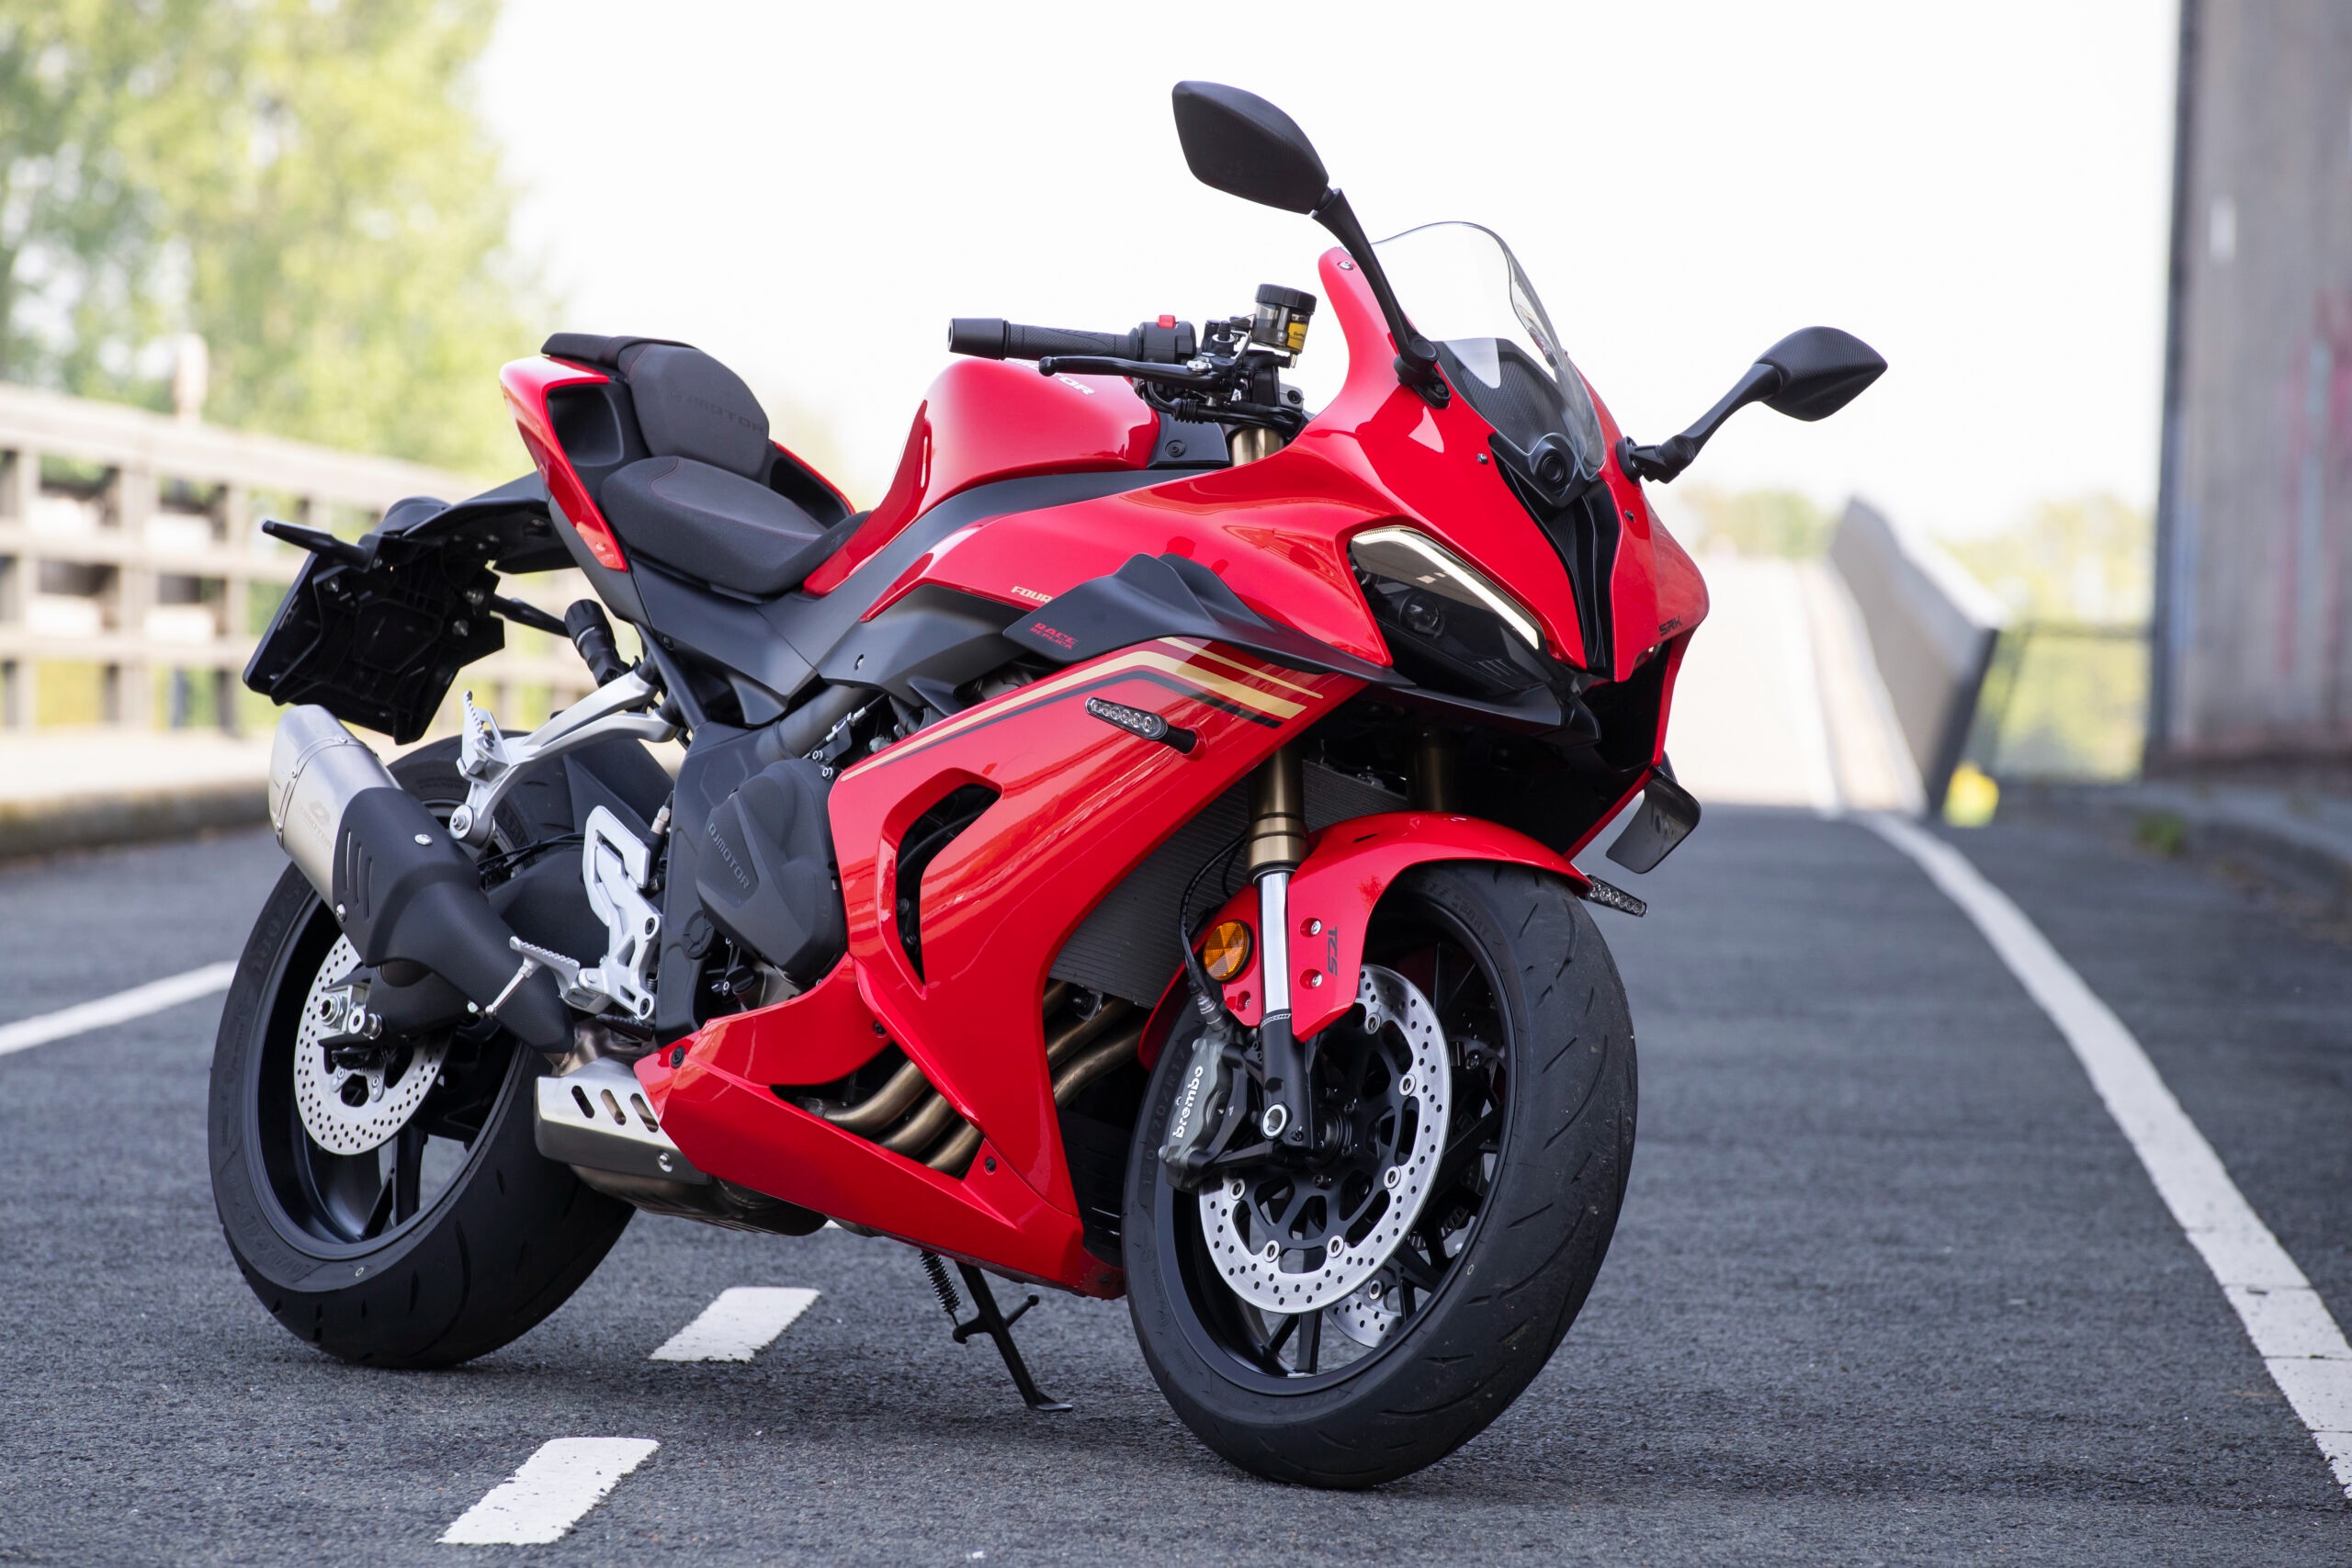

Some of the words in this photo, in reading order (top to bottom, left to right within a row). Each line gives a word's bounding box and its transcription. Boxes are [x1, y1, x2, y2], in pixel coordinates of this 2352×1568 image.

[1011, 586, 1053, 604] FOUR
[1035, 622, 1078, 644] RACE
[1658, 615, 1682, 637] SRK
[708, 822, 750, 890] QJMOTOR
[1328, 926, 1338, 976] TCS
[1172, 1066, 1204, 1138] brembo
